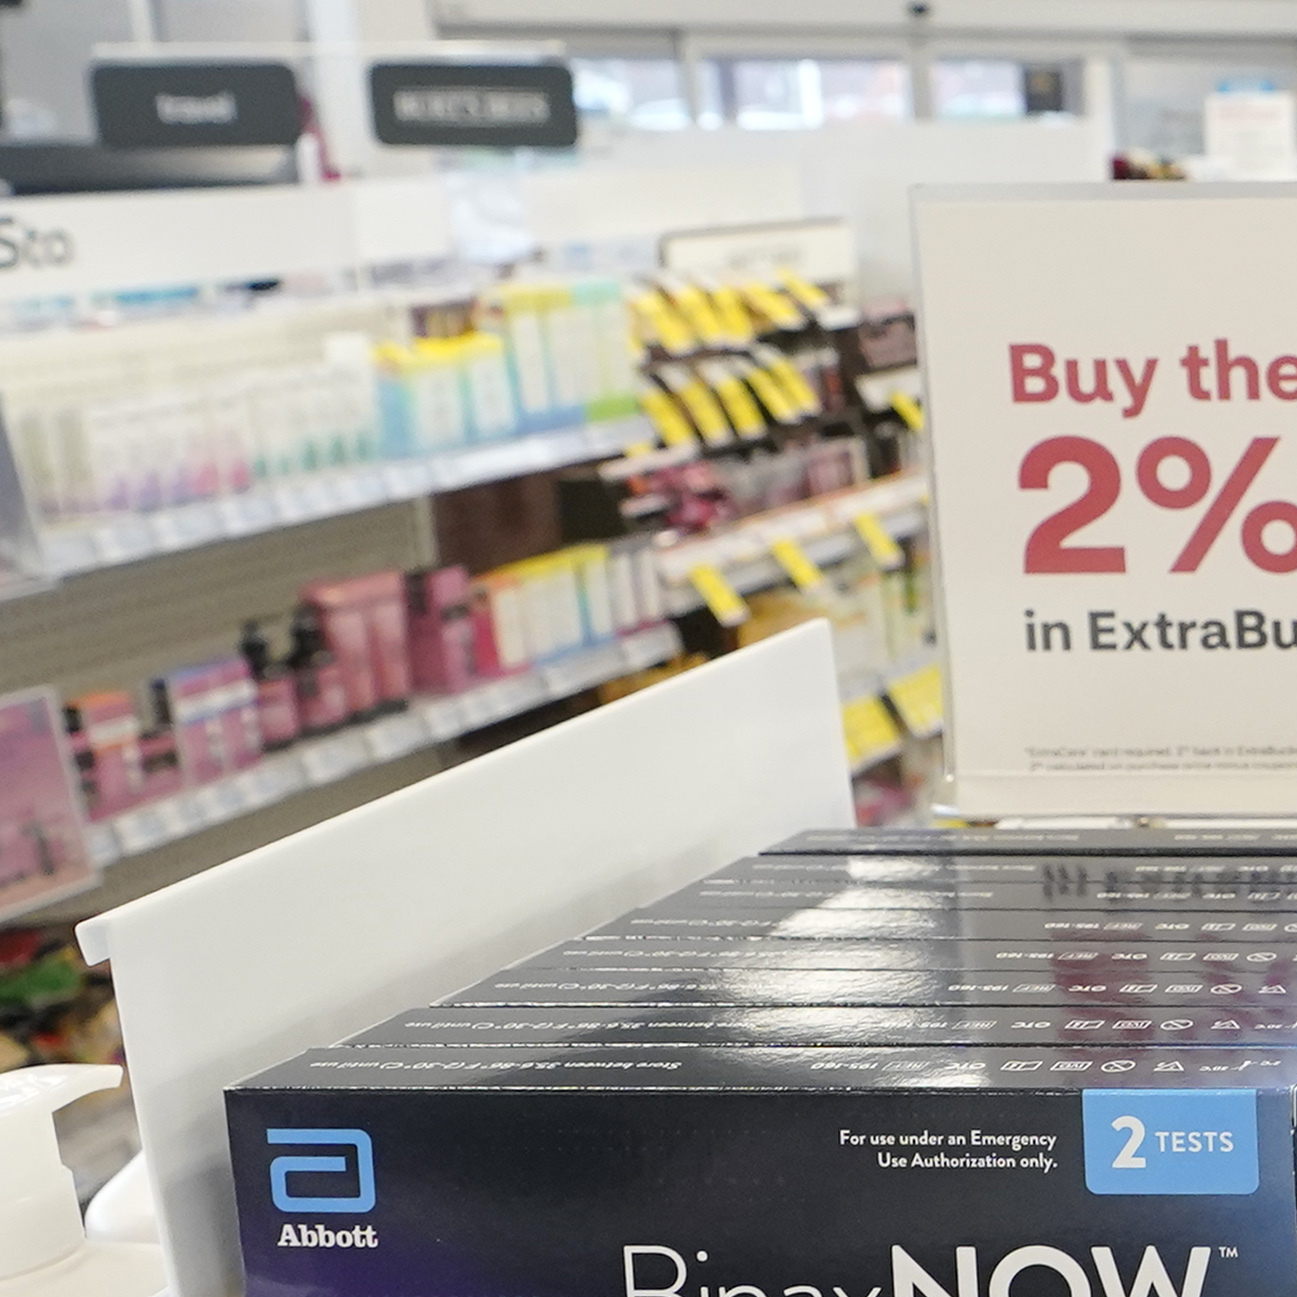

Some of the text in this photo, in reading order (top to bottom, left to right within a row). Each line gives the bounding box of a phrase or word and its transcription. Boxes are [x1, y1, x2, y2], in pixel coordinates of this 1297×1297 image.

[1008, 341, 1157, 419] Buy
[1025, 611, 1071, 652] in
[1111, 1116, 1234, 1169] 2 TESTS
[278, 1224, 378, 1248] Abbott
